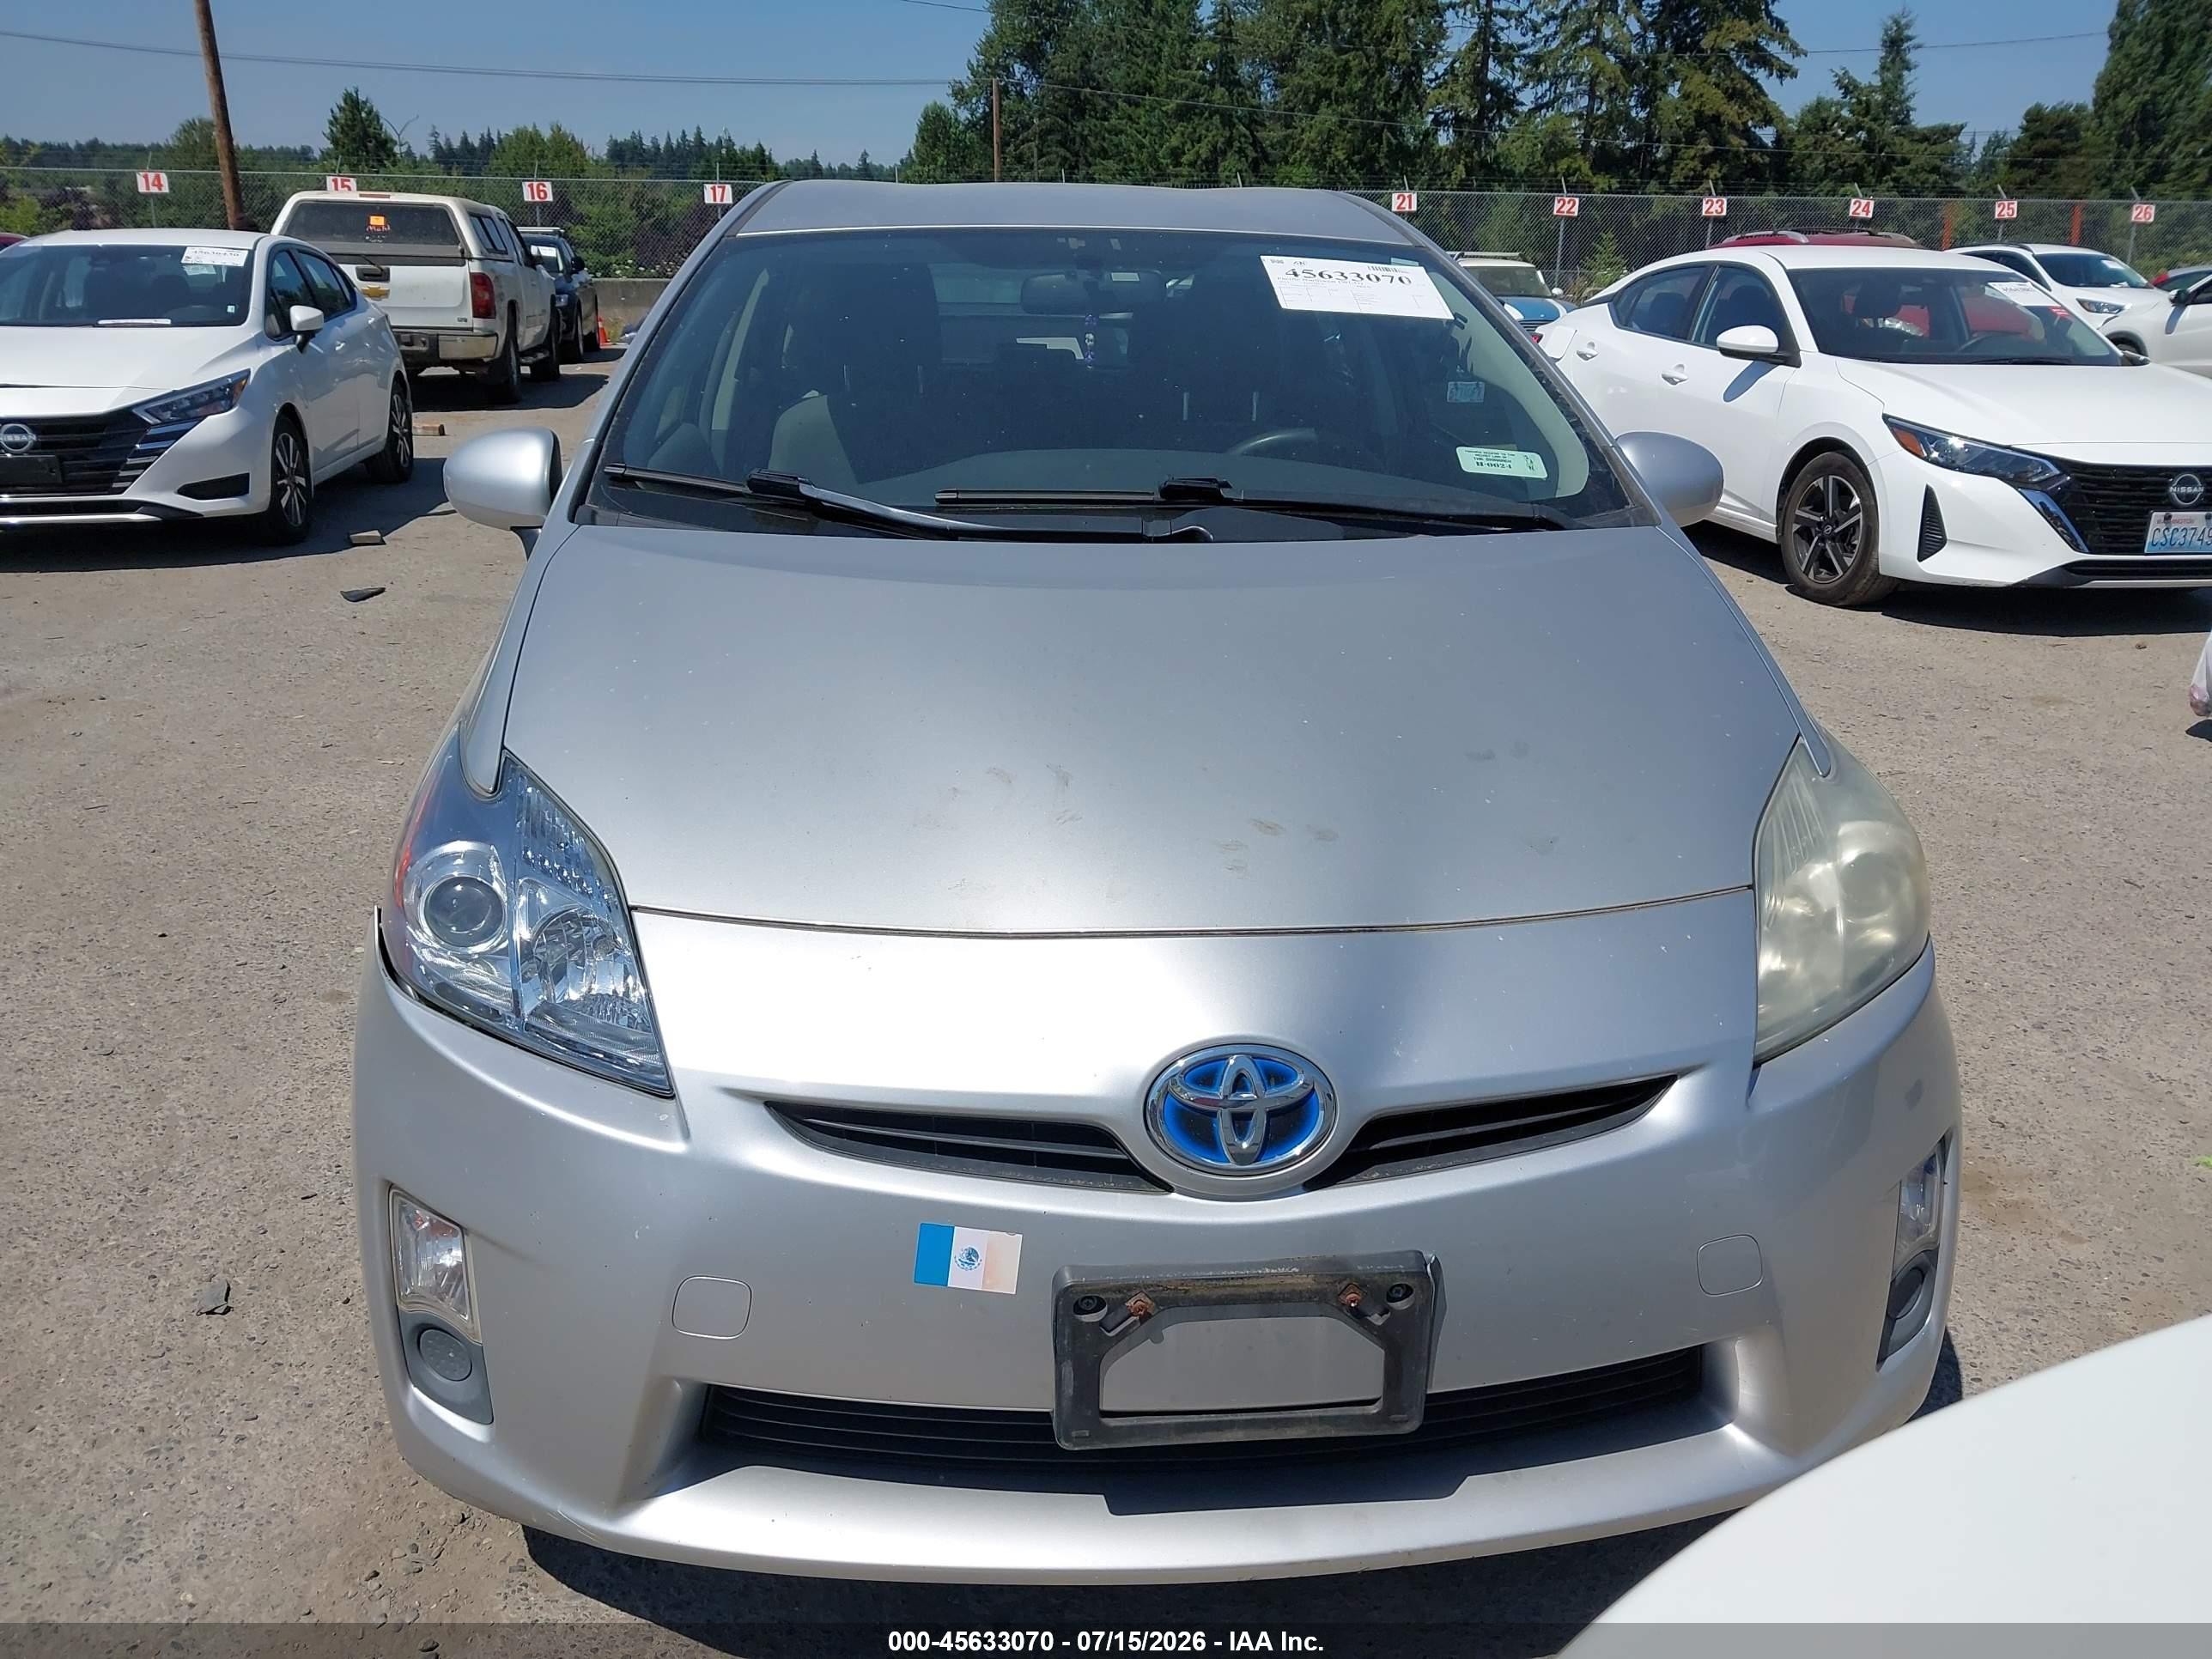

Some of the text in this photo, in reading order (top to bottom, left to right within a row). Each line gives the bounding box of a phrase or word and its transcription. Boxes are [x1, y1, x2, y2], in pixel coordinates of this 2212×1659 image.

[142, 173, 163, 191] 14
[331, 178, 350, 191] 15
[526, 183, 548, 200] 16
[710, 185, 726, 202] 17
[1396, 194, 1413, 210] 21
[1555, 198, 1577, 214] 22
[1704, 199, 1725, 215] 23
[1851, 200, 1871, 216] 24
[1996, 203, 2015, 216] 25
[2134, 205, 2153, 221] 26
[1285, 268, 1412, 285] 45633070
